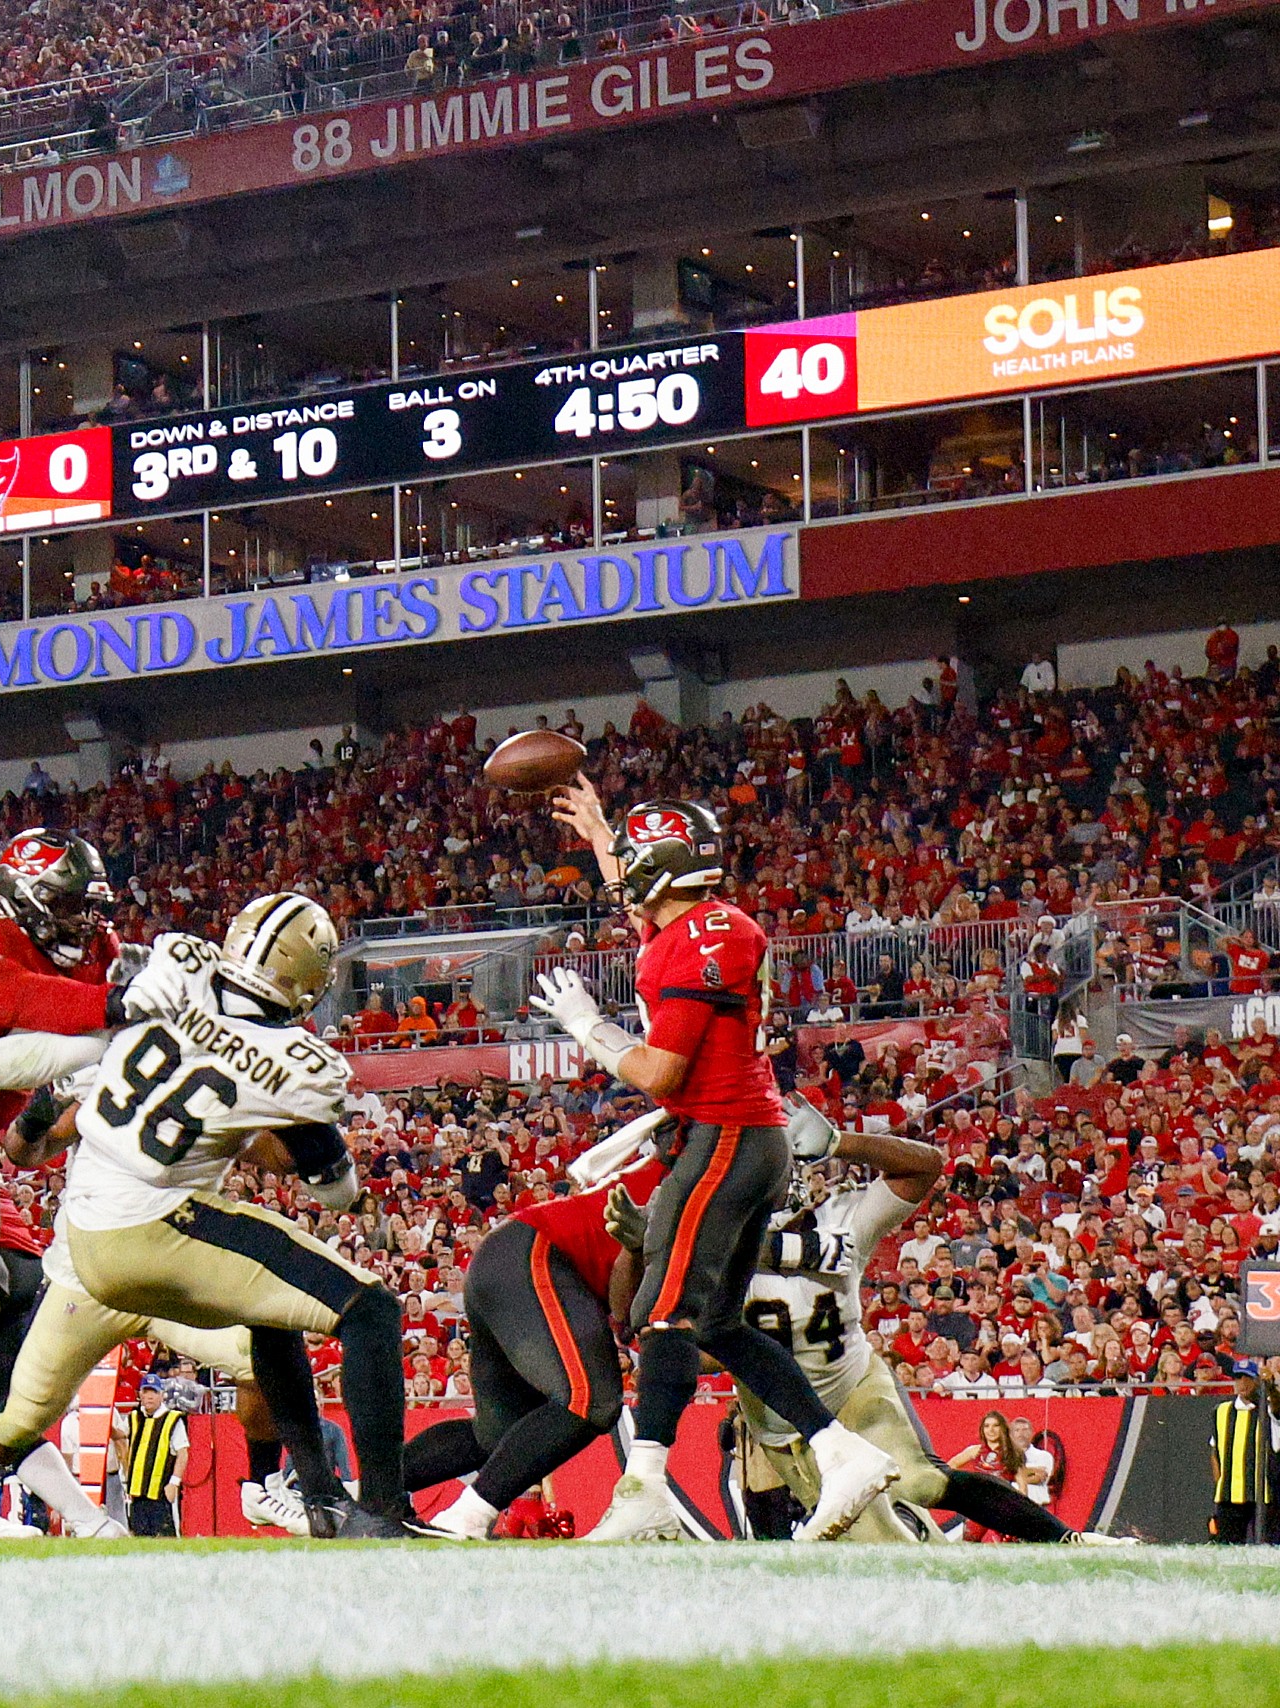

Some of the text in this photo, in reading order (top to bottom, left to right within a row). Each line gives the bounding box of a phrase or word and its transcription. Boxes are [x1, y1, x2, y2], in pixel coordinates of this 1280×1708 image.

[292, 37, 775, 172] 88 JIMMIE GILES
[983, 286, 1145, 355] SOLIS
[534, 343, 719, 386] 4TH QUARTER
[760, 342, 845, 398] 40
[993, 342, 1135, 378] HEALTH PLANS
[388, 378, 496, 411] BALL ON
[554, 372, 700, 438] 4:50
[130, 399, 354, 449] DOWN & DISTANCE
[422, 408, 462, 460] 3
[48, 443, 89, 495] 0
[132, 427, 337, 501] 3RD & 10
[205, 578, 441, 665] JAMES
[459, 531, 792, 633] STADIUM
[688, 909, 732, 939] 12
[180, 1006, 293, 1097] NDERSON
[97, 1024, 238, 1166] 96
